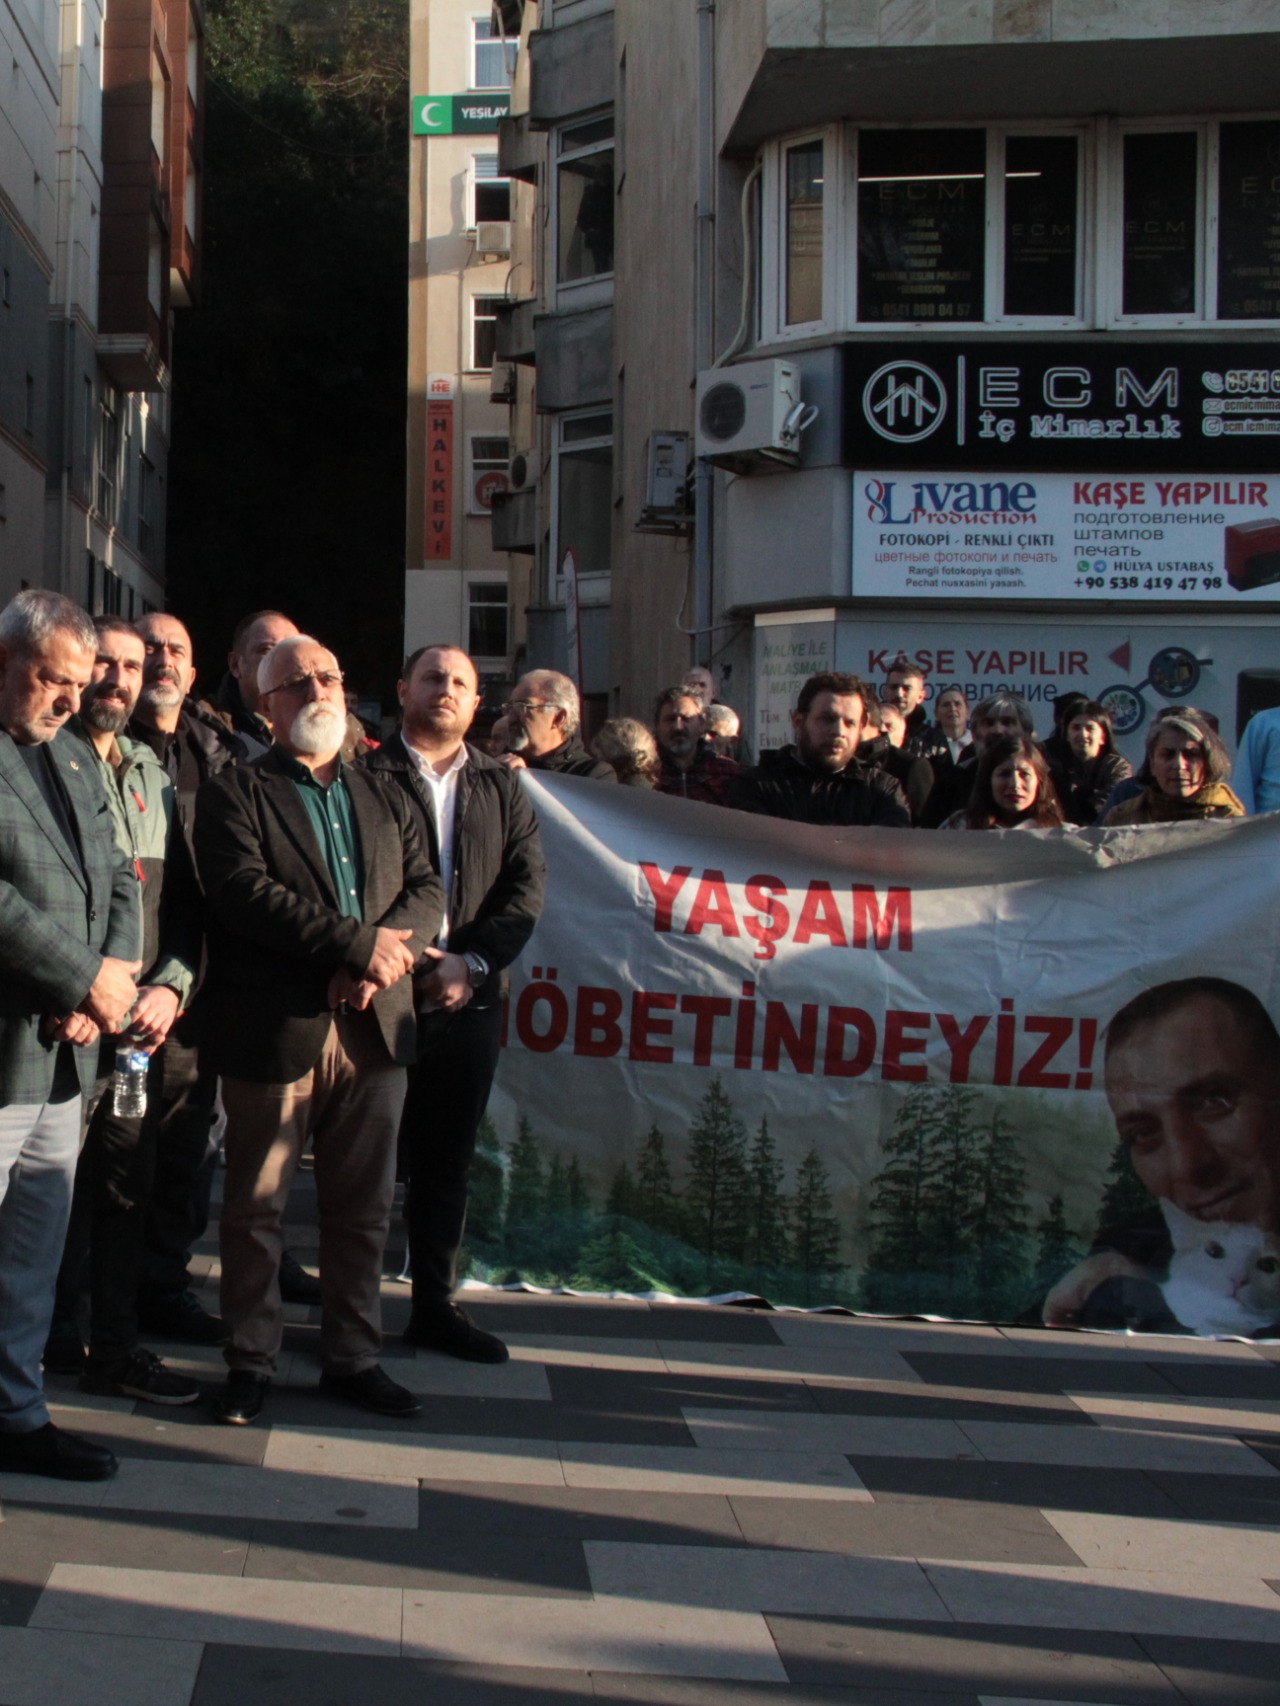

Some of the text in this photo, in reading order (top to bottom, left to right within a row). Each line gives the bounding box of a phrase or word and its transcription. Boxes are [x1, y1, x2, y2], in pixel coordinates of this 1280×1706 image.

[461, 106, 508, 120] YEŞİLAY
[978, 367, 1178, 408] ECM
[1226, 370, 1269, 392] 0541
[978, 410, 1181, 441] İç Mimarlık
[883, 481, 1037, 524] Livane
[1074, 482, 1269, 510] KAŞE YAPILIR
[912, 508, 1037, 525] Production
[1074, 512, 1225, 525] подготовление
[879, 530, 950, 546] FOTOKOPİ
[964, 530, 1012, 546] RENKLİ
[1017, 533, 1054, 550] ÇIKTI
[1074, 529, 1164, 540] штампов
[874, 553, 930, 564] цветные
[1001, 553, 1009, 562] и
[1013, 552, 1058, 562] печать
[1074, 545, 1141, 557] печать
[908, 566, 939, 577] Rangli
[942, 566, 993, 577] fotokopiya
[1113, 559, 1214, 574] HÜLYA USTABAŞ
[905, 578, 939, 588] Pechat
[1074, 577, 1222, 590] +90 538 419 47 98
[966, 650, 1089, 675] YAPILIR
[638, 861, 914, 960] YAŞAM
[500, 966, 1098, 1090] ÖBETİNDEYİZ!
